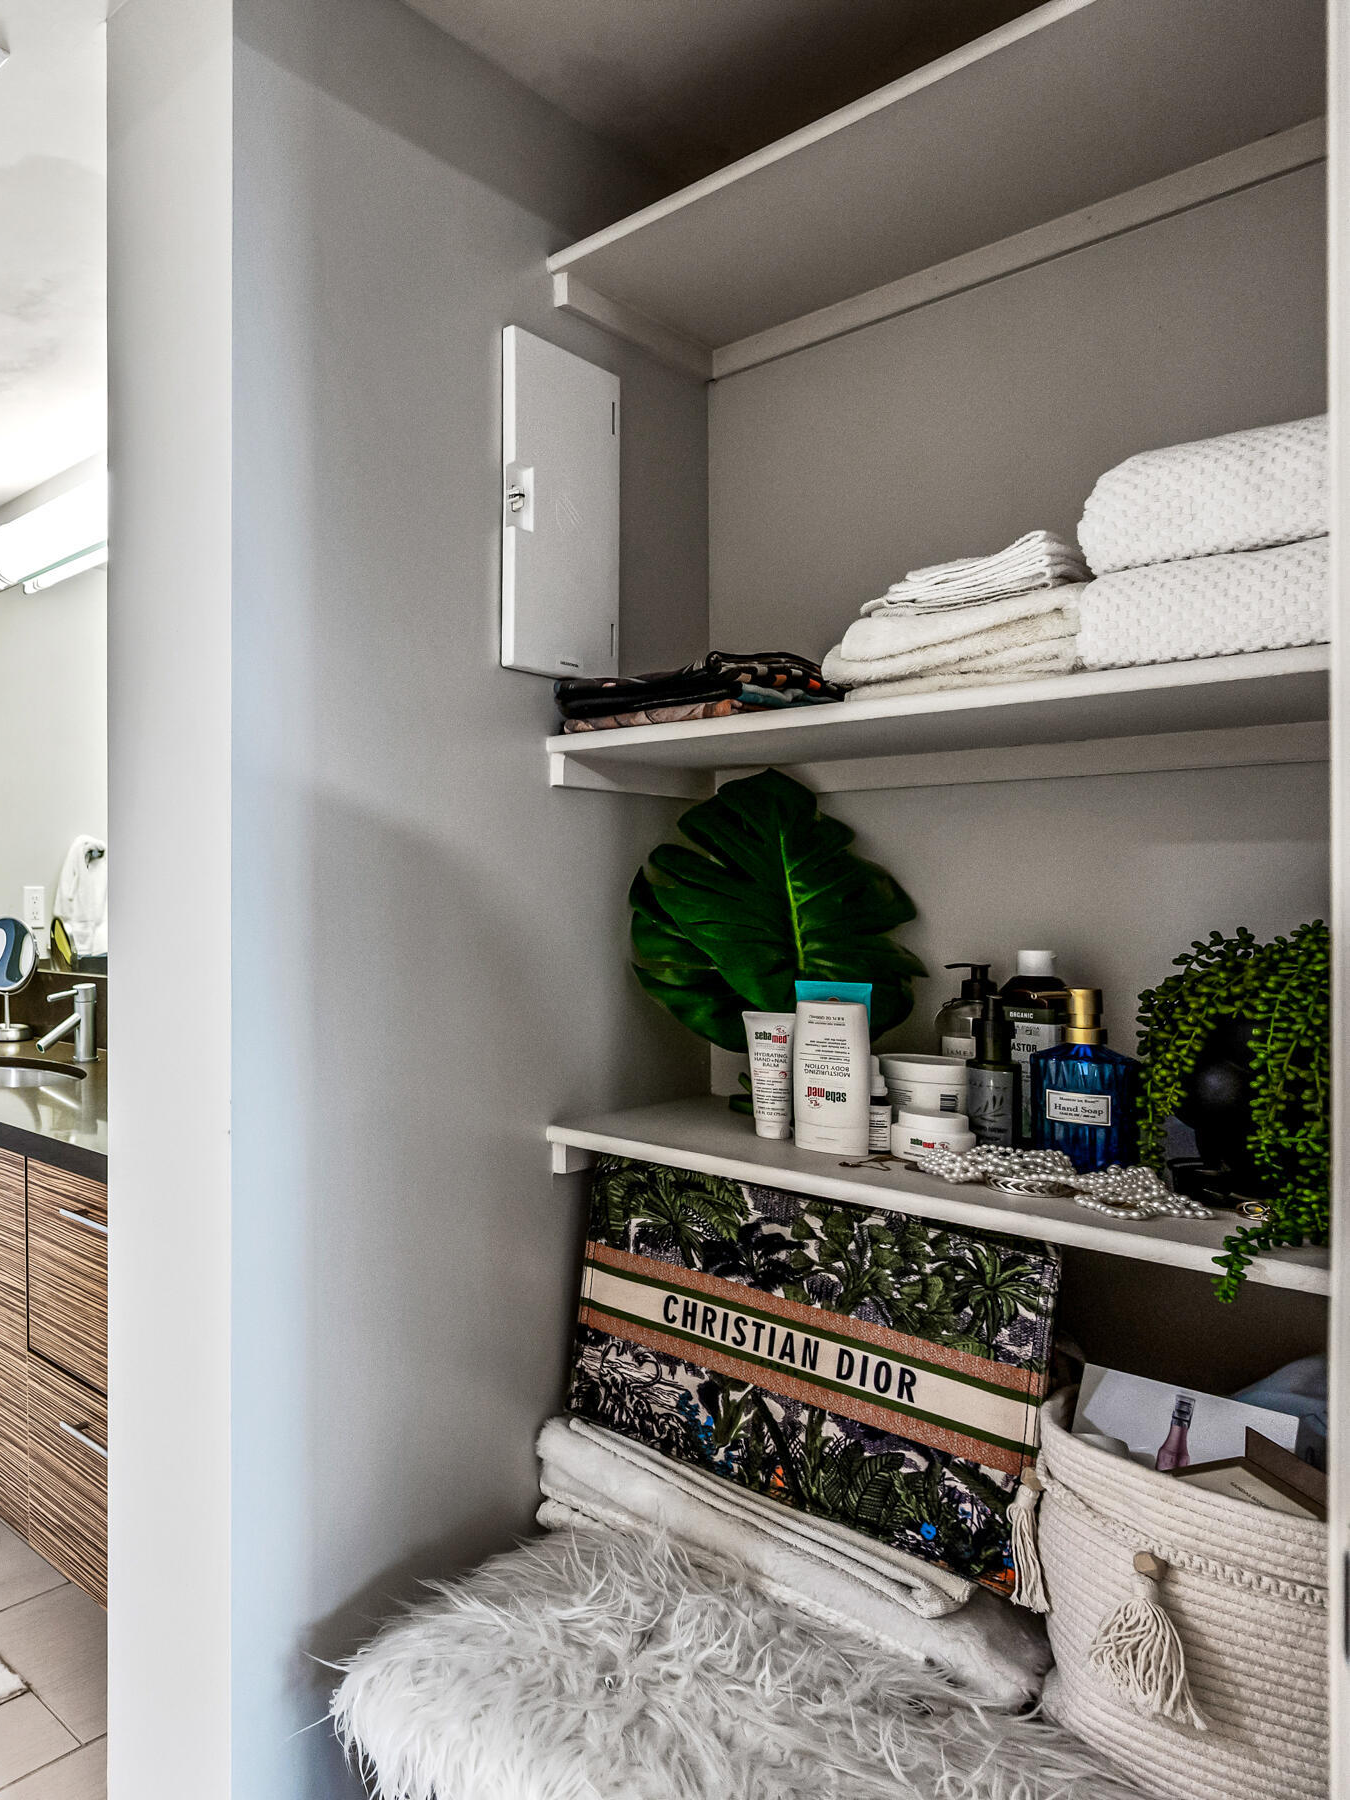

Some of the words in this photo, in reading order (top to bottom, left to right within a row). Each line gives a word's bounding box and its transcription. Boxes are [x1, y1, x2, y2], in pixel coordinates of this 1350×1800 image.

[1009, 1011, 1034, 1019] ORGANIC
[754, 1031, 788, 1044] sebamed
[1010, 1042, 1037, 1053] ASTOR
[754, 1051, 788, 1059] HYDRATING
[804, 1063, 829, 1071] LOTION
[804, 1068, 851, 1078] MOISTURIZING
[806, 1086, 847, 1103] sebamed
[1053, 1103, 1078, 1113] Hand
[1080, 1106, 1104, 1117] Soap
[662, 1294, 820, 1372] CHRISTIAN
[836, 1347, 917, 1404] DIOR
